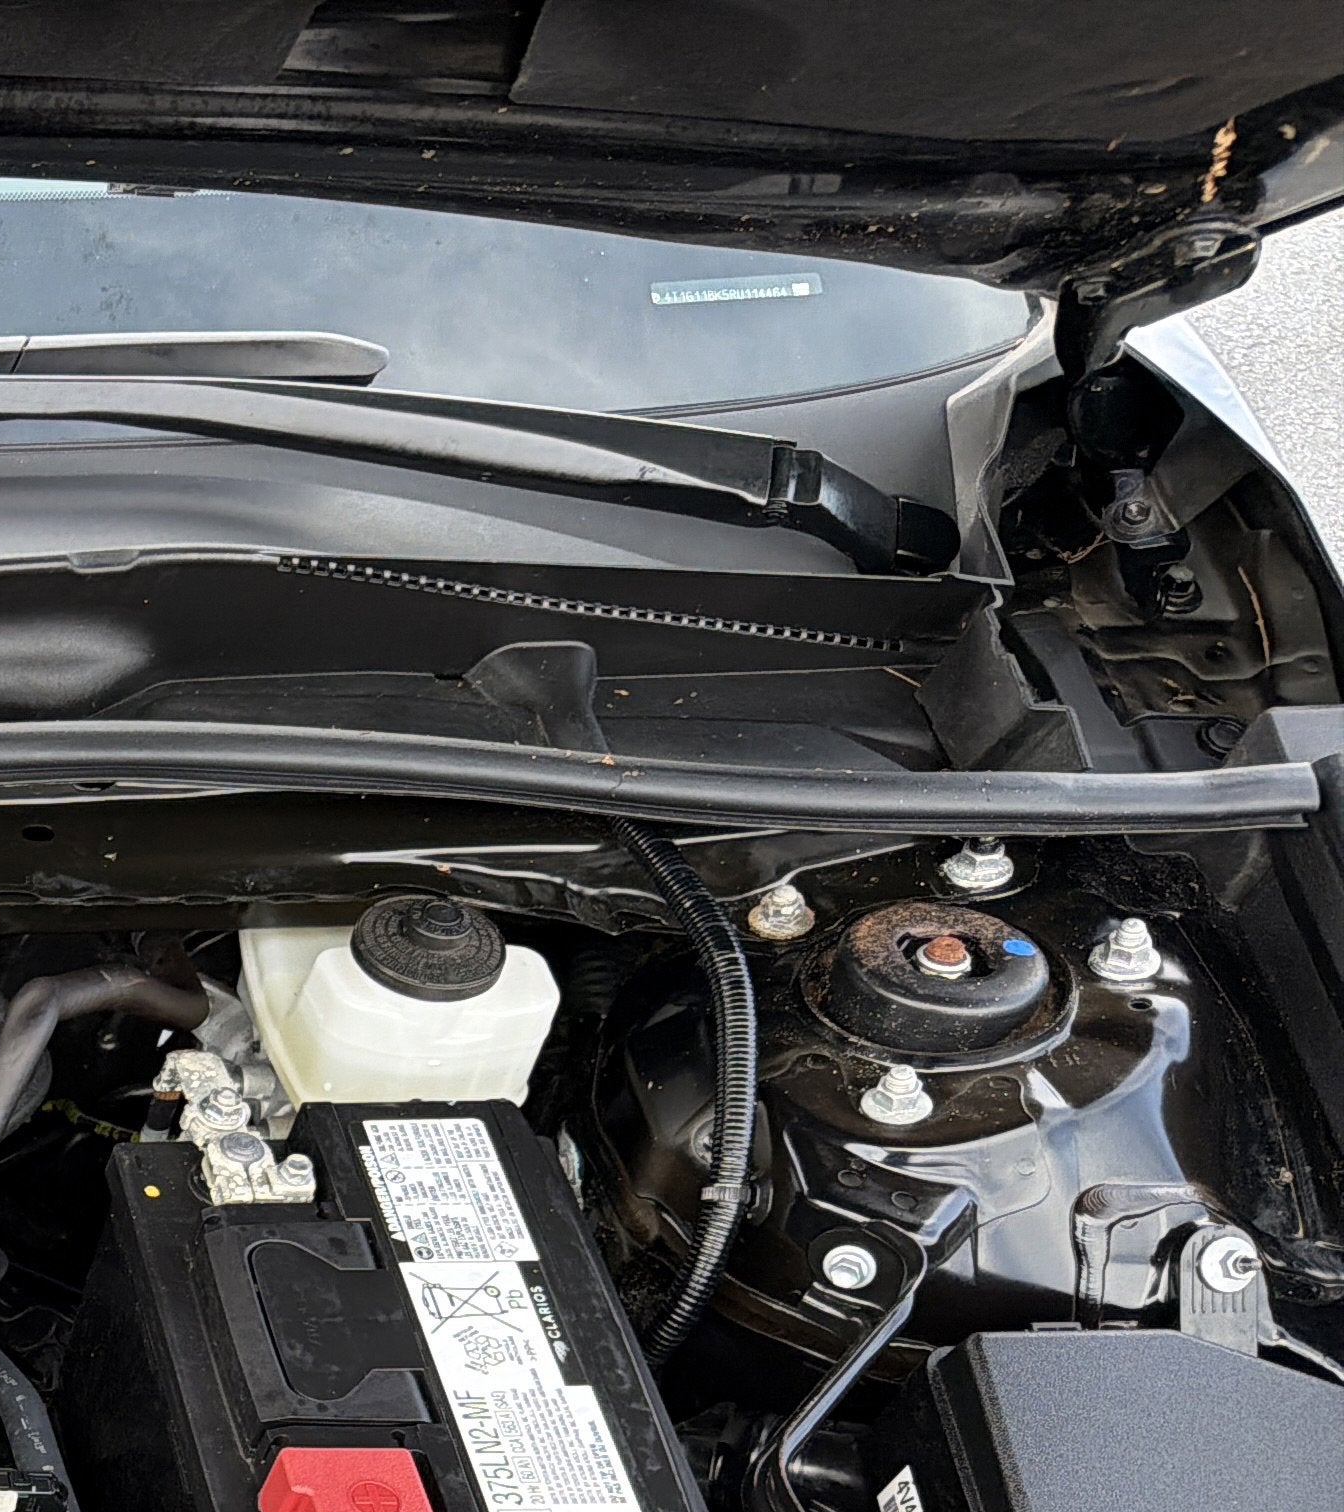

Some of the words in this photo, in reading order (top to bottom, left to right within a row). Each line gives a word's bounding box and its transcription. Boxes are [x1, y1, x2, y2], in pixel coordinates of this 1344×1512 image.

[506, 1288, 528, 1310] Pb
[530, 1285, 561, 1339] CLARIOS
[453, 1390, 523, 1505] 375LN2-MF
